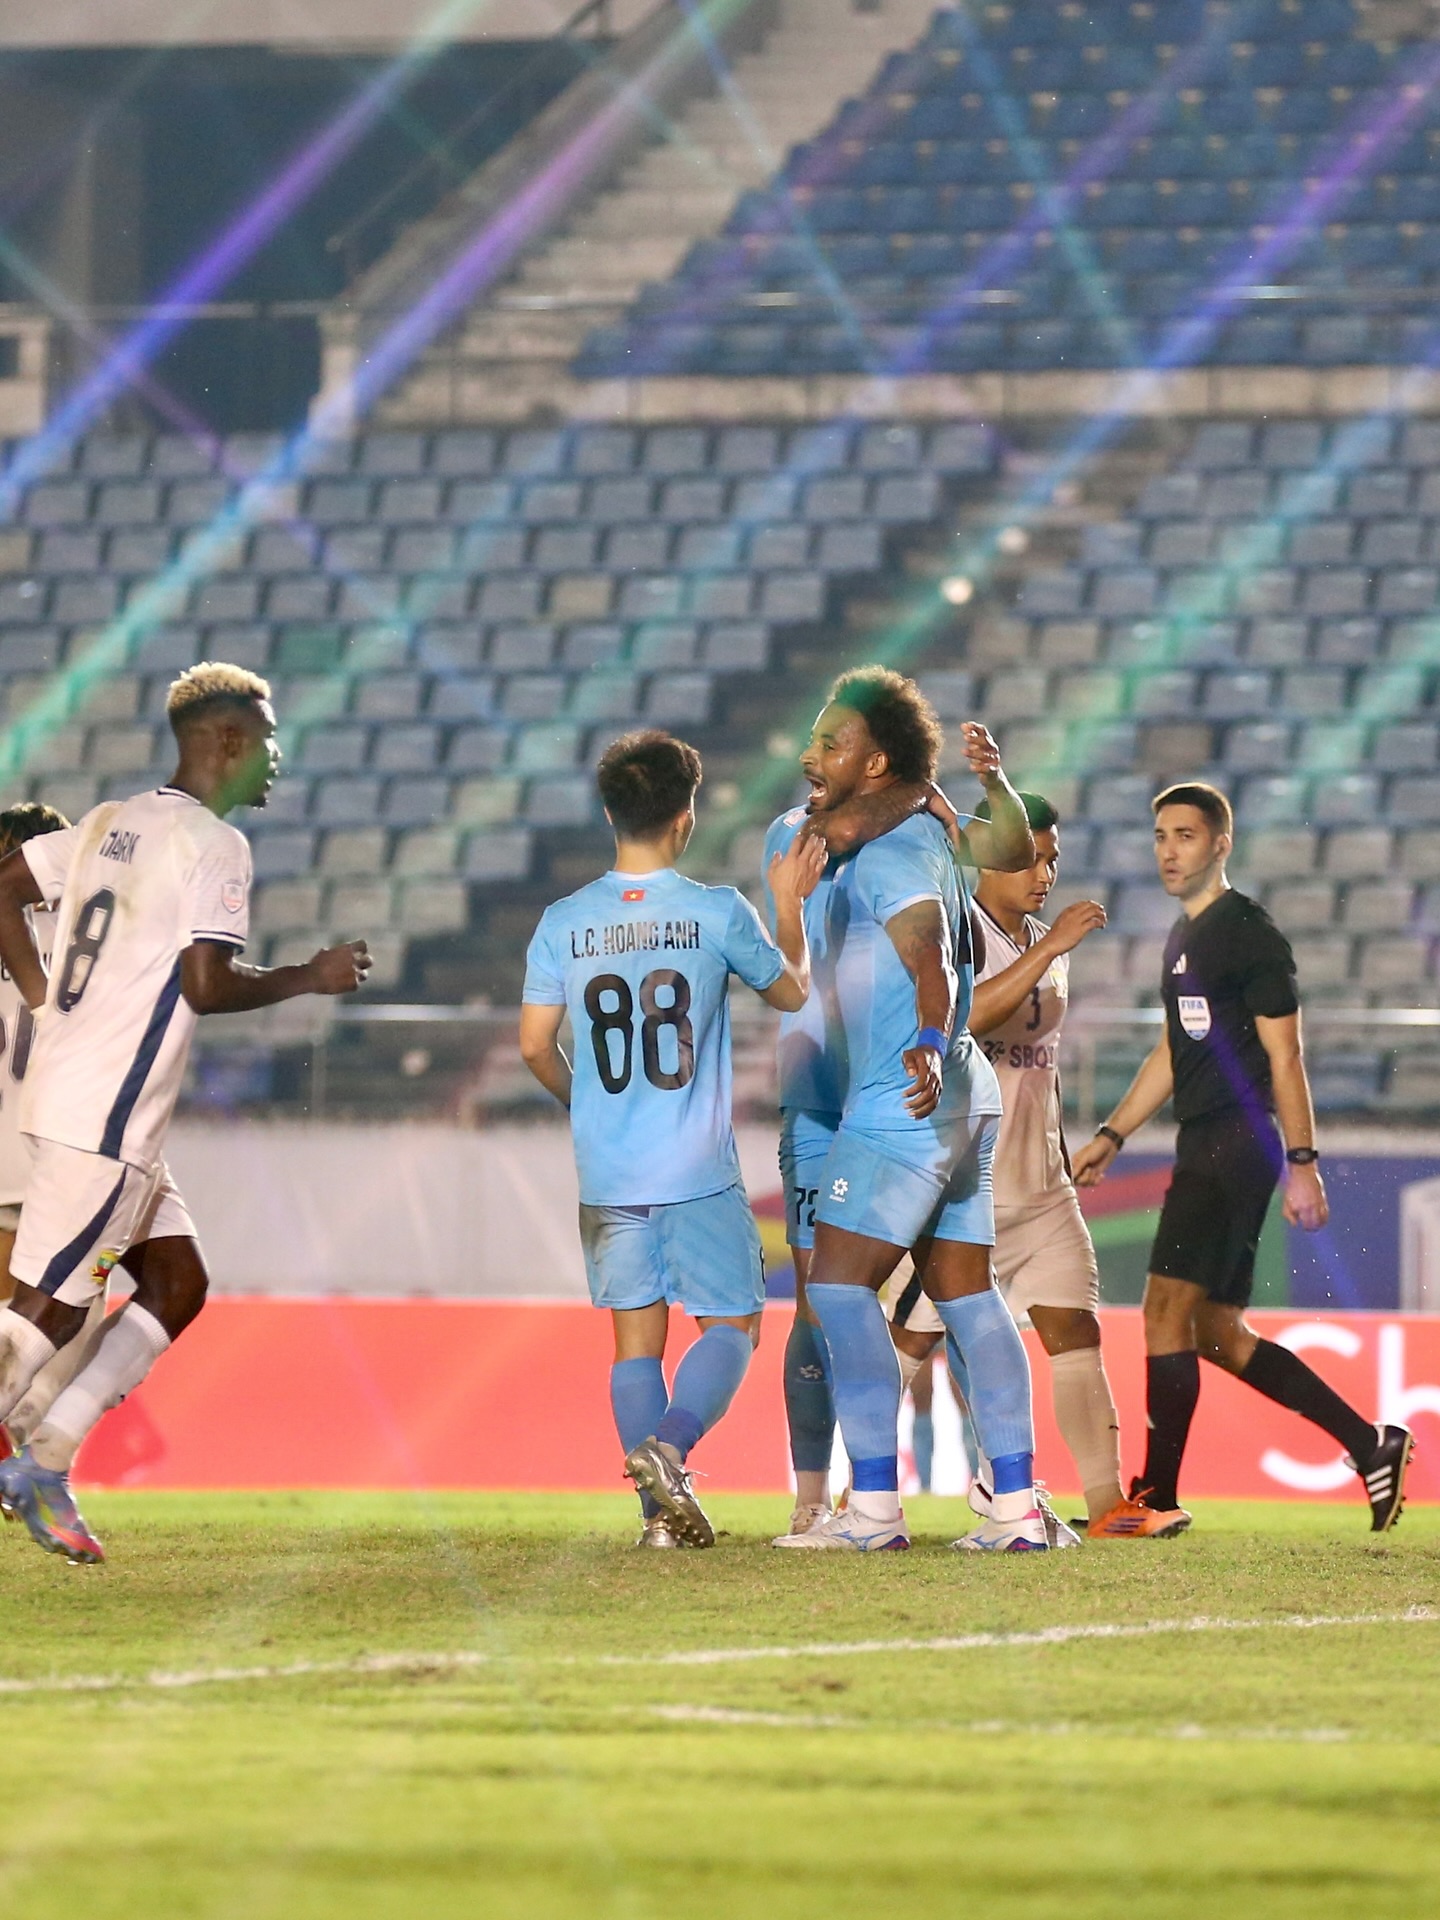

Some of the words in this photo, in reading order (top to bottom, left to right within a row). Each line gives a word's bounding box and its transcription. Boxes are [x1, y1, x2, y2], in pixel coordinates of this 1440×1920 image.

[57, 887, 116, 1015] 8
[571, 928, 599, 959] L.C.
[604, 921, 659, 955] HOANG
[664, 921, 700, 949] ANH
[584, 969, 695, 1094] 88
[1025, 986, 1041, 1032] 3
